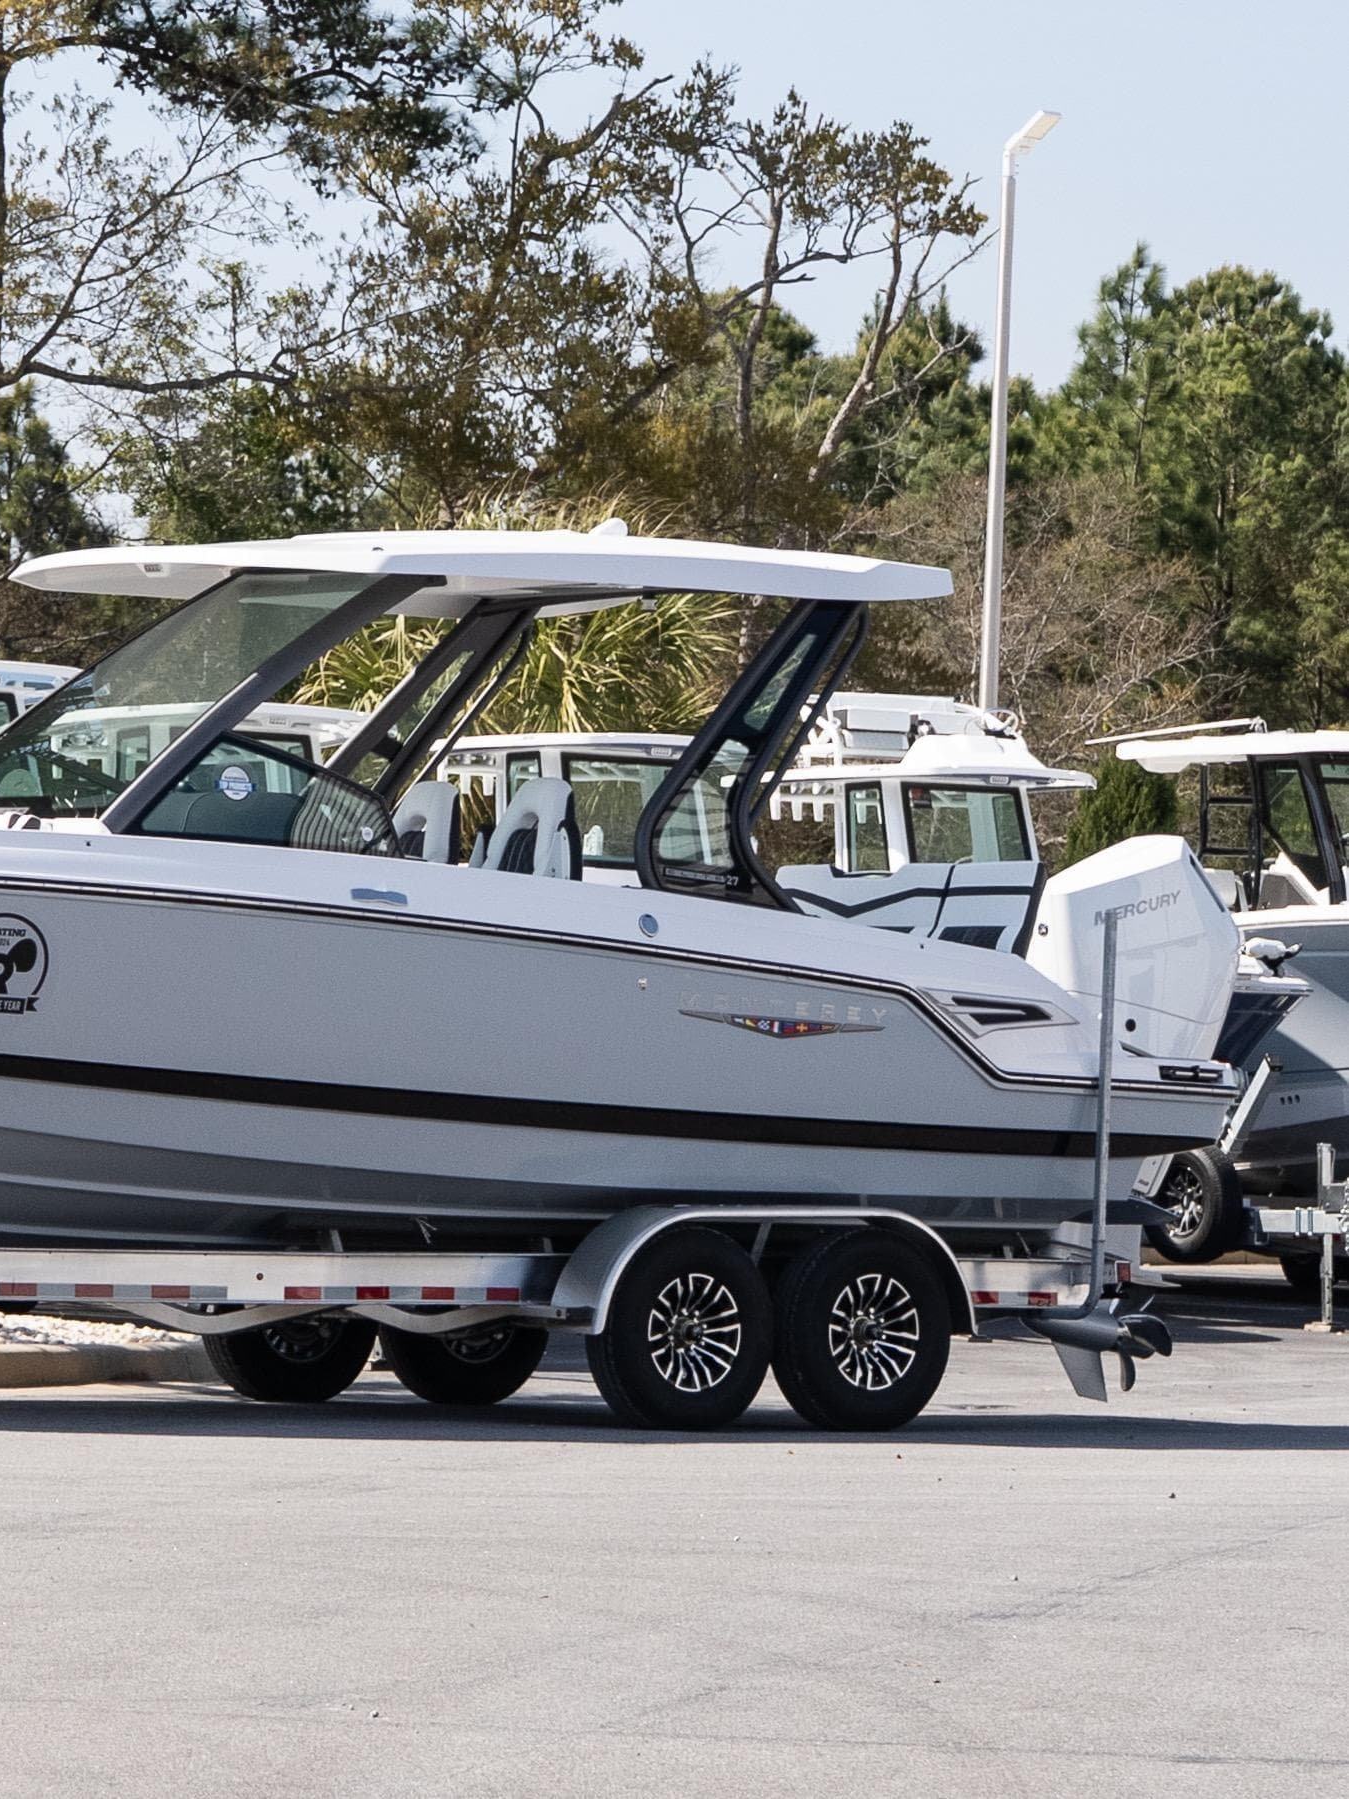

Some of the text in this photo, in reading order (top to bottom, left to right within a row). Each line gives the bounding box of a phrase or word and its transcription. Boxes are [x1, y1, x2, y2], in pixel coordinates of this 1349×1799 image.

[726, 875, 738, 887] 27
[1094, 889, 1181, 926] MERCURY
[4, 1001, 21, 1011] YEAR
